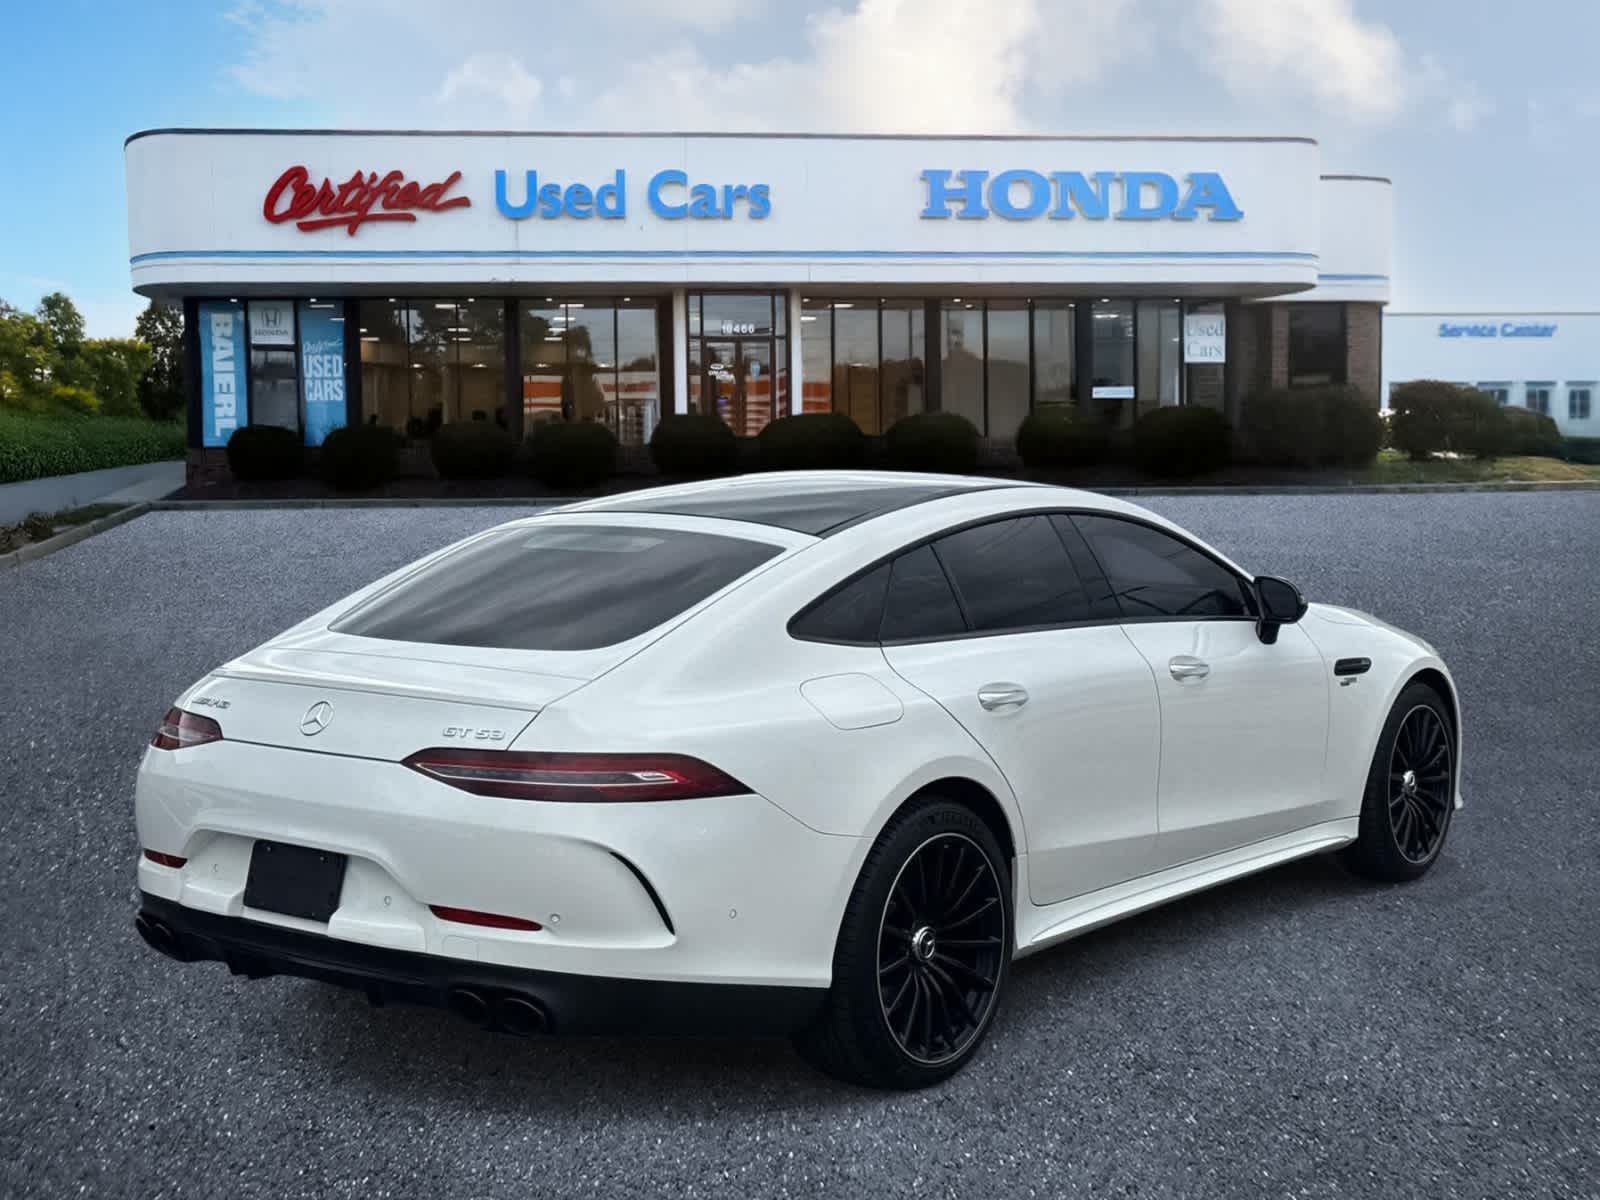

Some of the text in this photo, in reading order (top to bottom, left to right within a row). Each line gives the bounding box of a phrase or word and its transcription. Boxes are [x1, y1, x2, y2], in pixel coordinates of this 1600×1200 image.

[263, 165, 771, 236] Certified Used Cars
[920, 169, 1245, 221] HONDA
[1185, 319, 1224, 337] Used
[1438, 321, 1557, 337] Service Center
[1186, 341, 1223, 357] Cars
[210, 312, 237, 437] BAIERL
[303, 354, 343, 377] USED
[304, 379, 344, 401] CARS
[442, 727, 505, 741] GT 53
